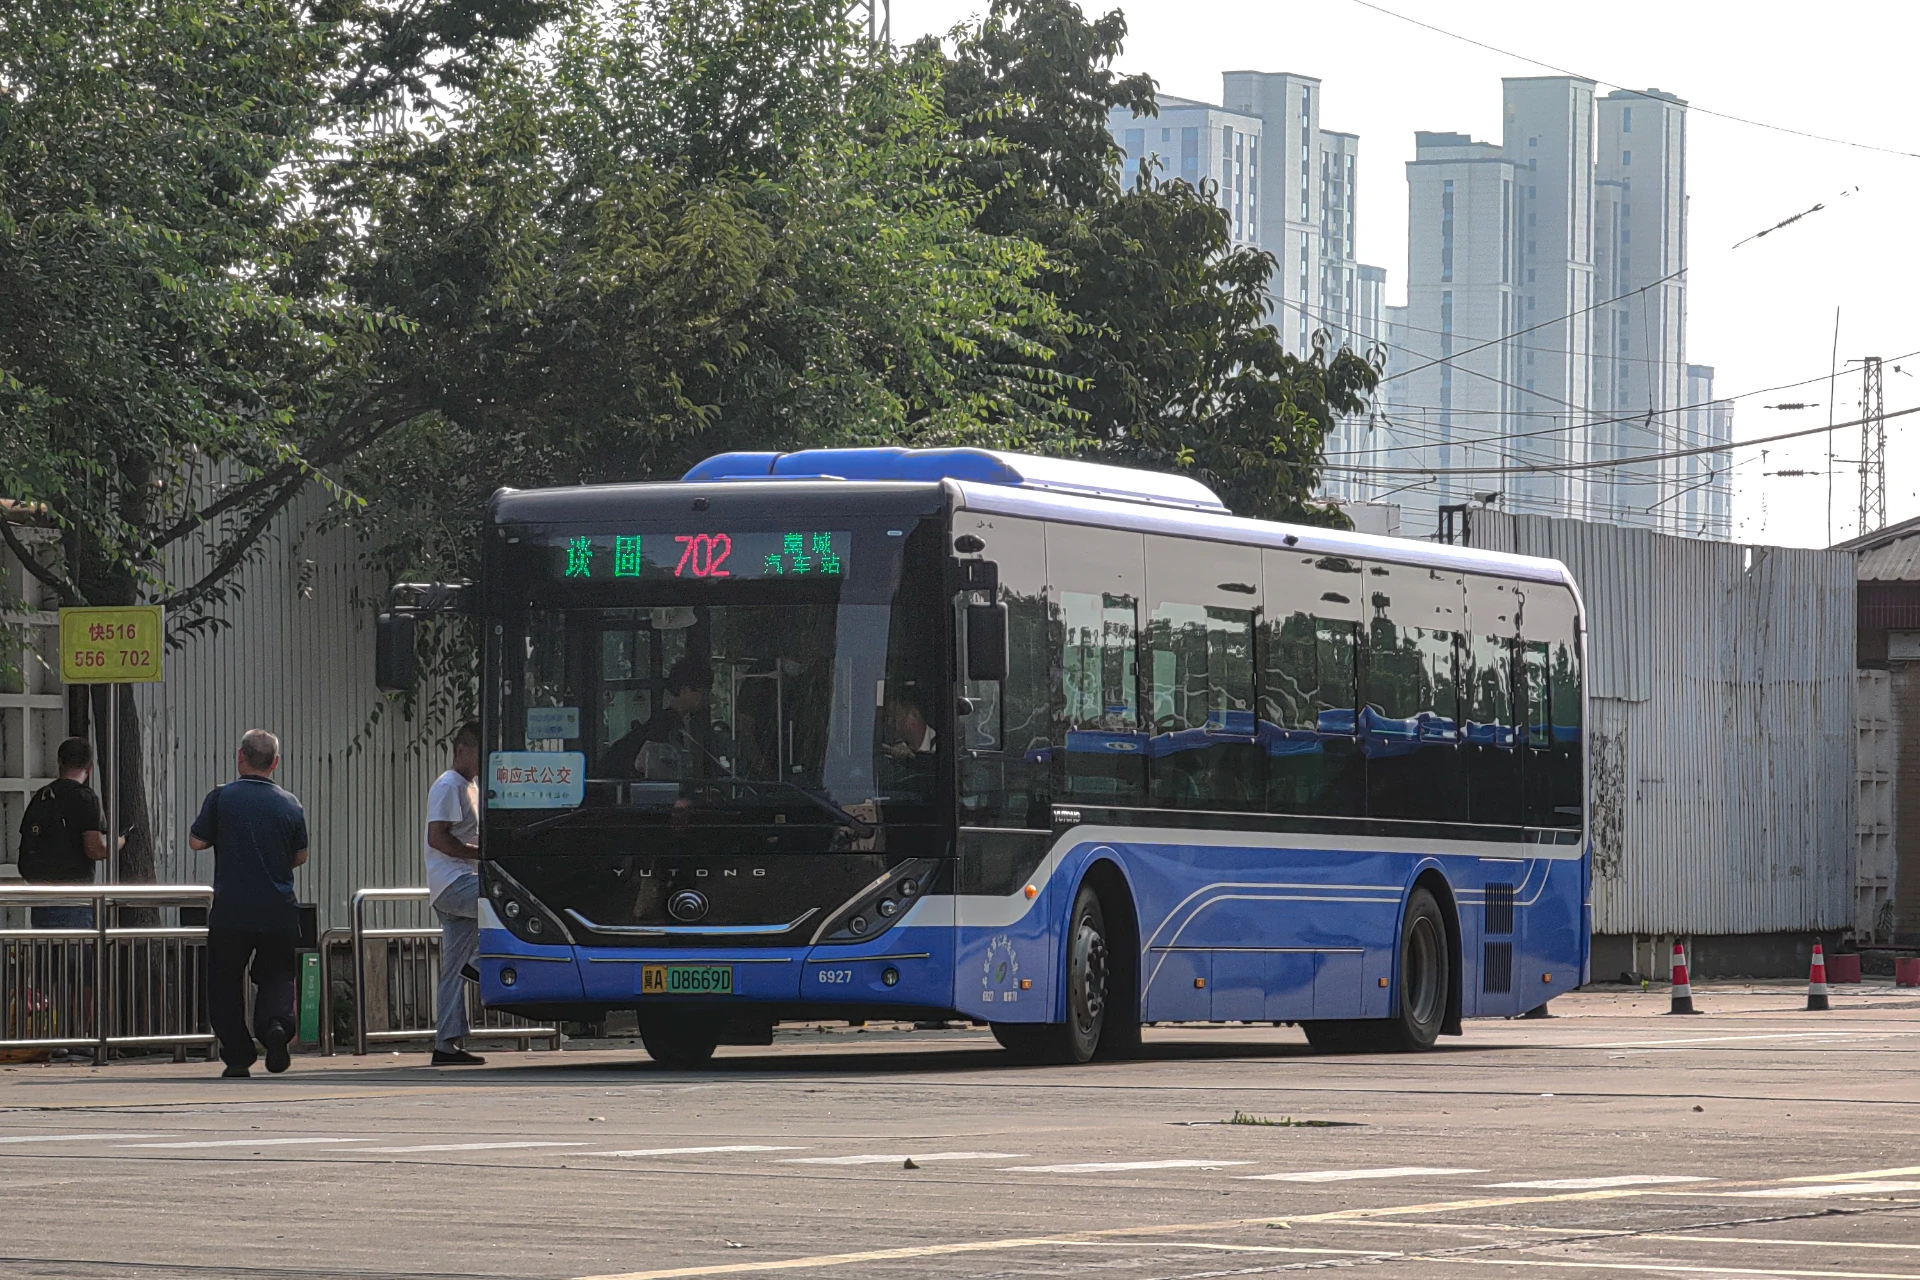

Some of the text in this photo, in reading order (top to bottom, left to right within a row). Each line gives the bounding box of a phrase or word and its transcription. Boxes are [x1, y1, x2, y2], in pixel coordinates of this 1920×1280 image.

[674, 533, 732, 577] 702
[764, 553, 840, 574] 汽车站
[89, 623, 136, 641] 快516
[75, 650, 150, 667] 556 702
[496, 765, 572, 784] 响应式公交
[1053, 810, 1081, 823] YUTONG
[613, 868, 766, 877] YUTONG
[818, 970, 852, 984] 6927
